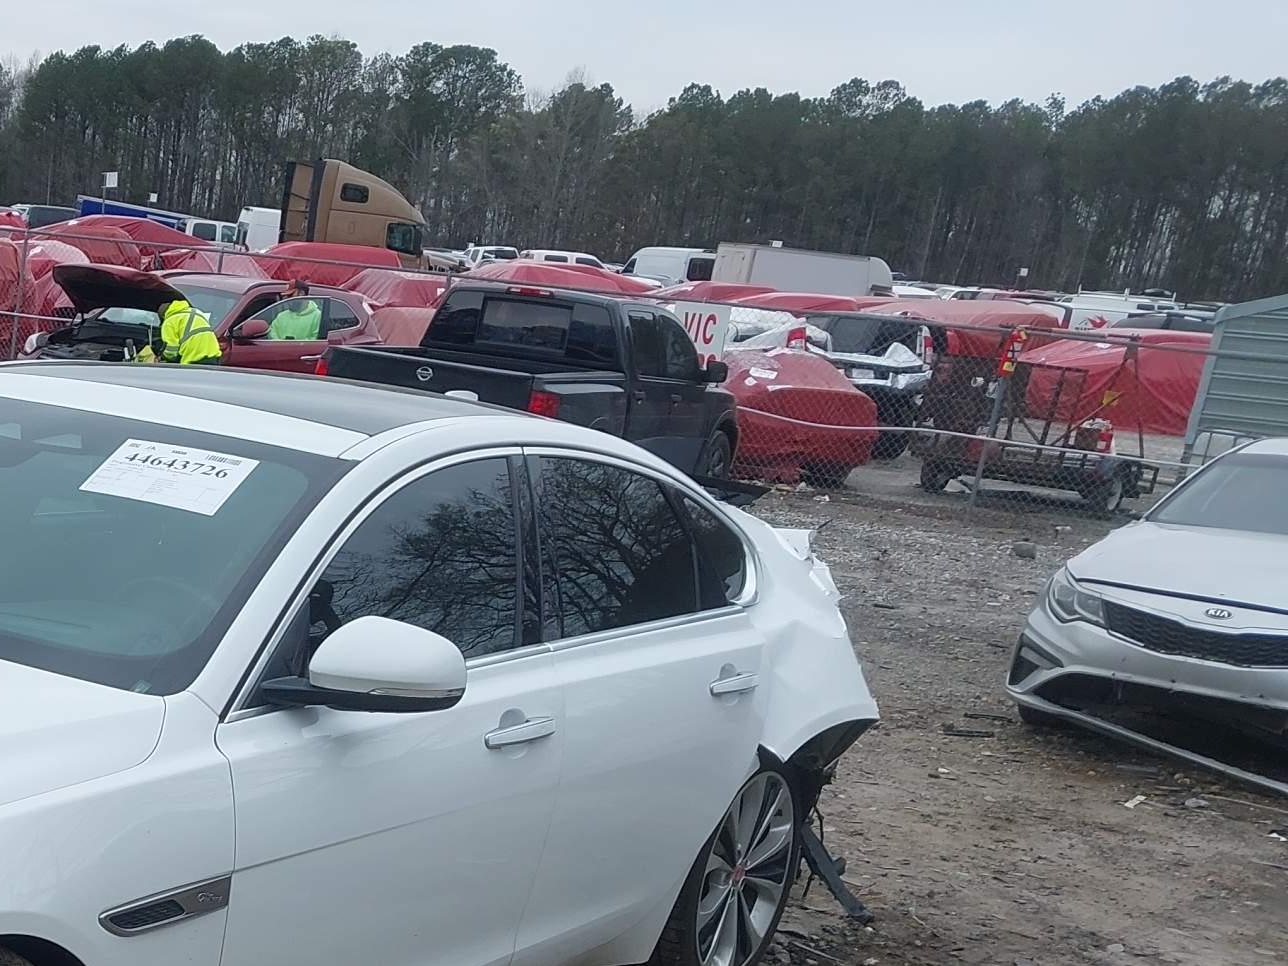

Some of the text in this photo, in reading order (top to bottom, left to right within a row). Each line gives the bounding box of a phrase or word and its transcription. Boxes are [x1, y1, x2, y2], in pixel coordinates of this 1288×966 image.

[684, 312, 716, 344] VIC
[125, 453, 232, 479] 44643726
[1208, 609, 1229, 618] KIA
